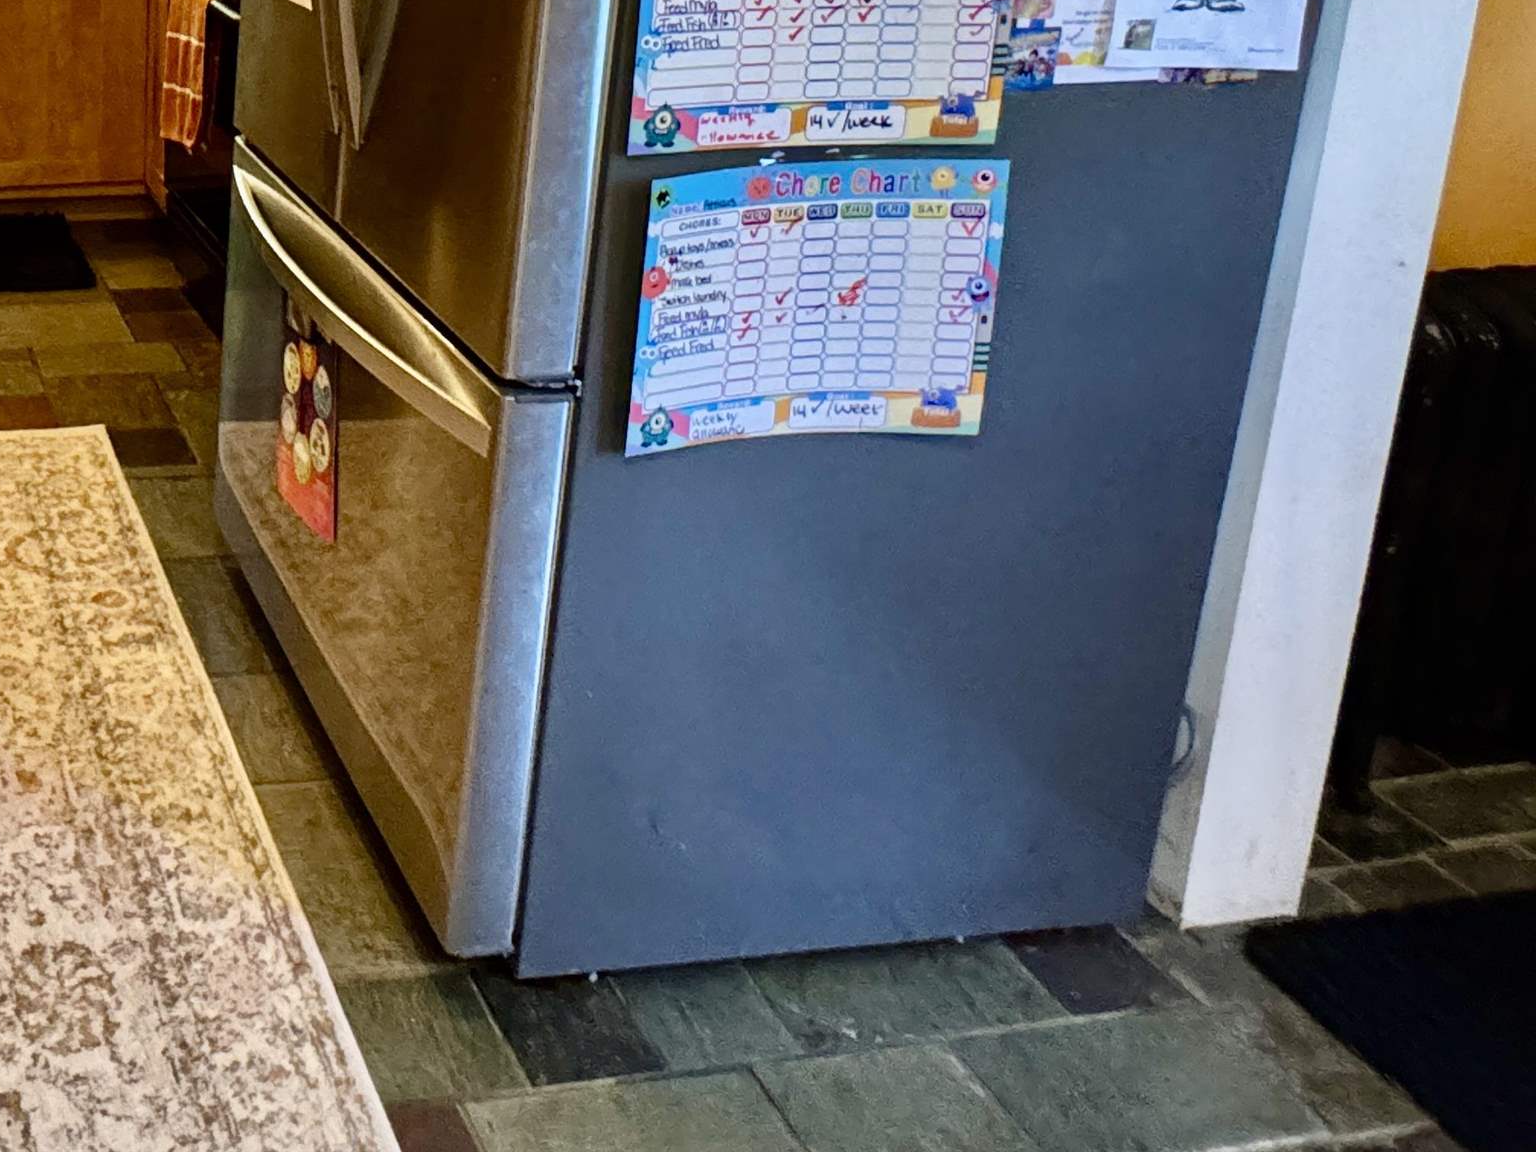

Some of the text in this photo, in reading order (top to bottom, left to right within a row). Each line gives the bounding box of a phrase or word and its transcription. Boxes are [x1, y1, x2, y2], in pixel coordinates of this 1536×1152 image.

[775, 167, 922, 198] Chore Chart
[776, 208, 801, 218] TUE
[843, 204, 871, 216] THU
[879, 203, 905, 216] FRI
[917, 203, 944, 215] SAT
